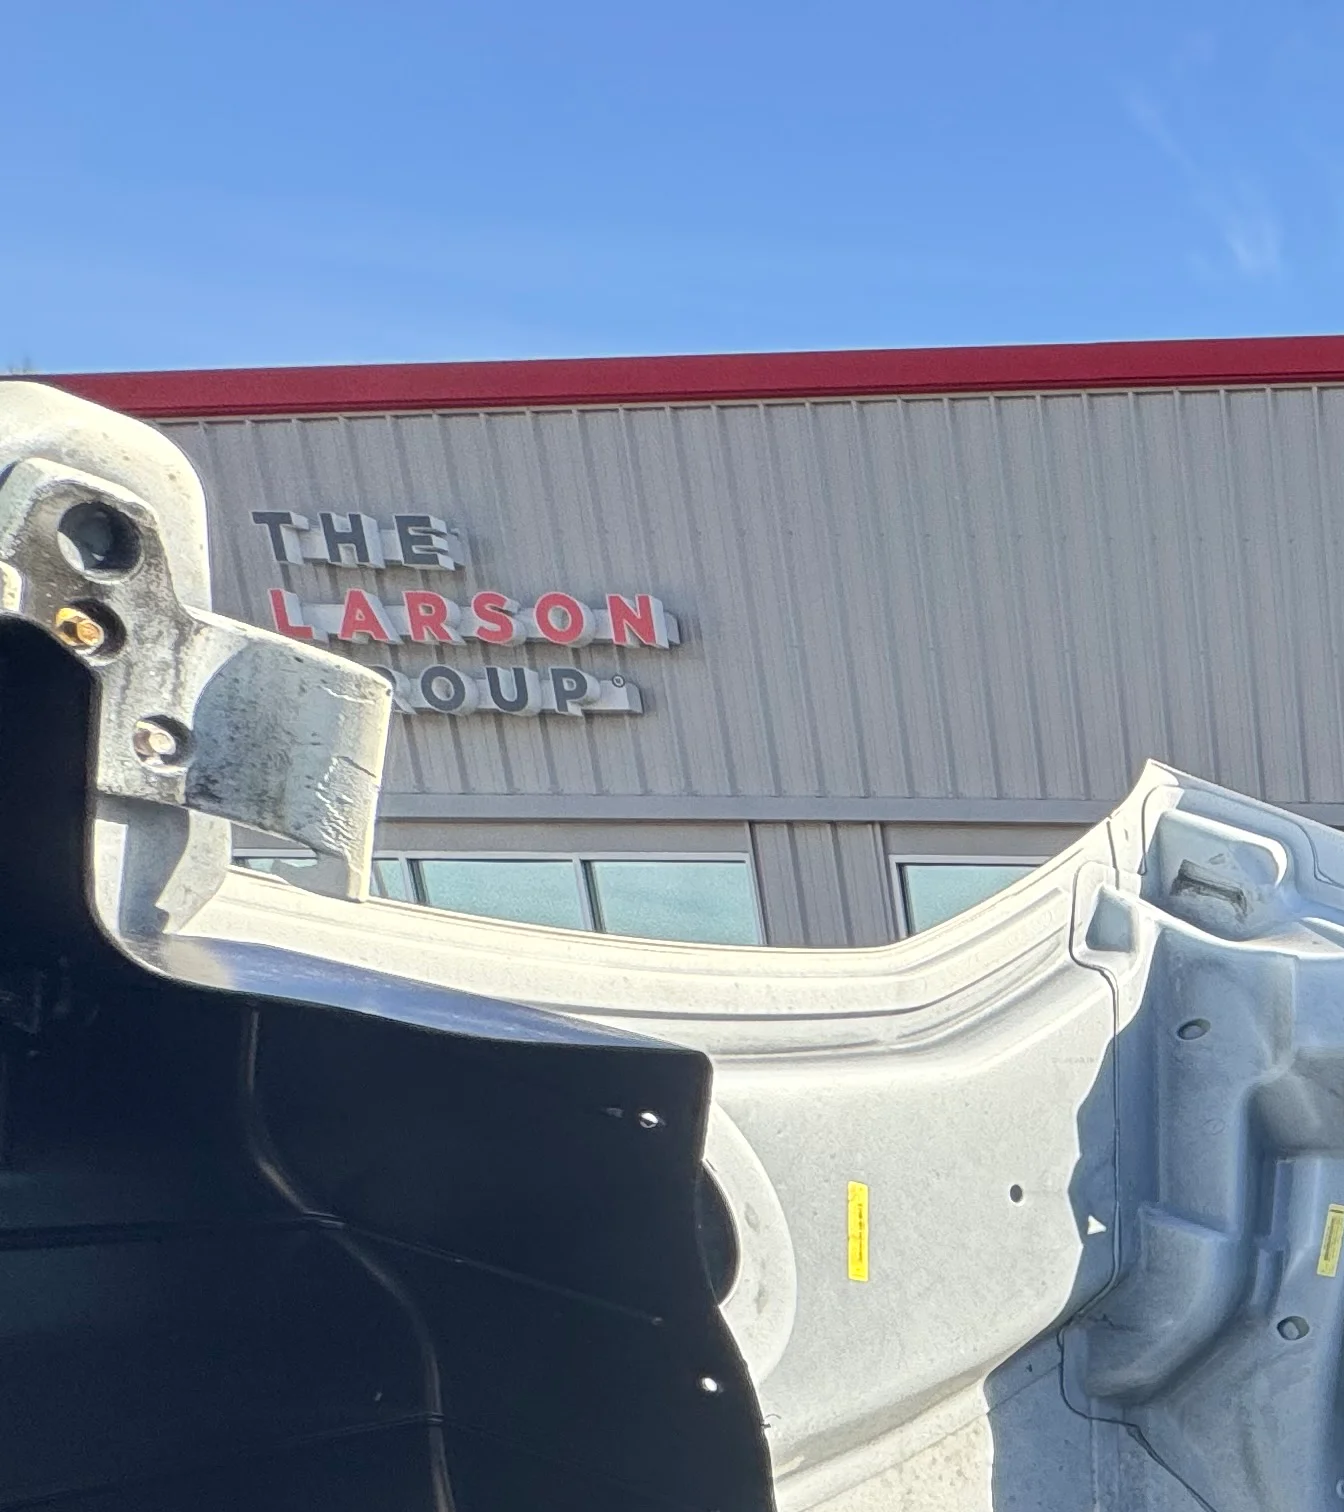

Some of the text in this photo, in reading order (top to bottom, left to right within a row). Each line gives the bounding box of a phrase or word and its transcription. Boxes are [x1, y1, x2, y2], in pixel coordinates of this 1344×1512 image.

[253, 511, 440, 566] THE
[268, 588, 659, 646] LARSON
[369, 664, 588, 713] OUP
